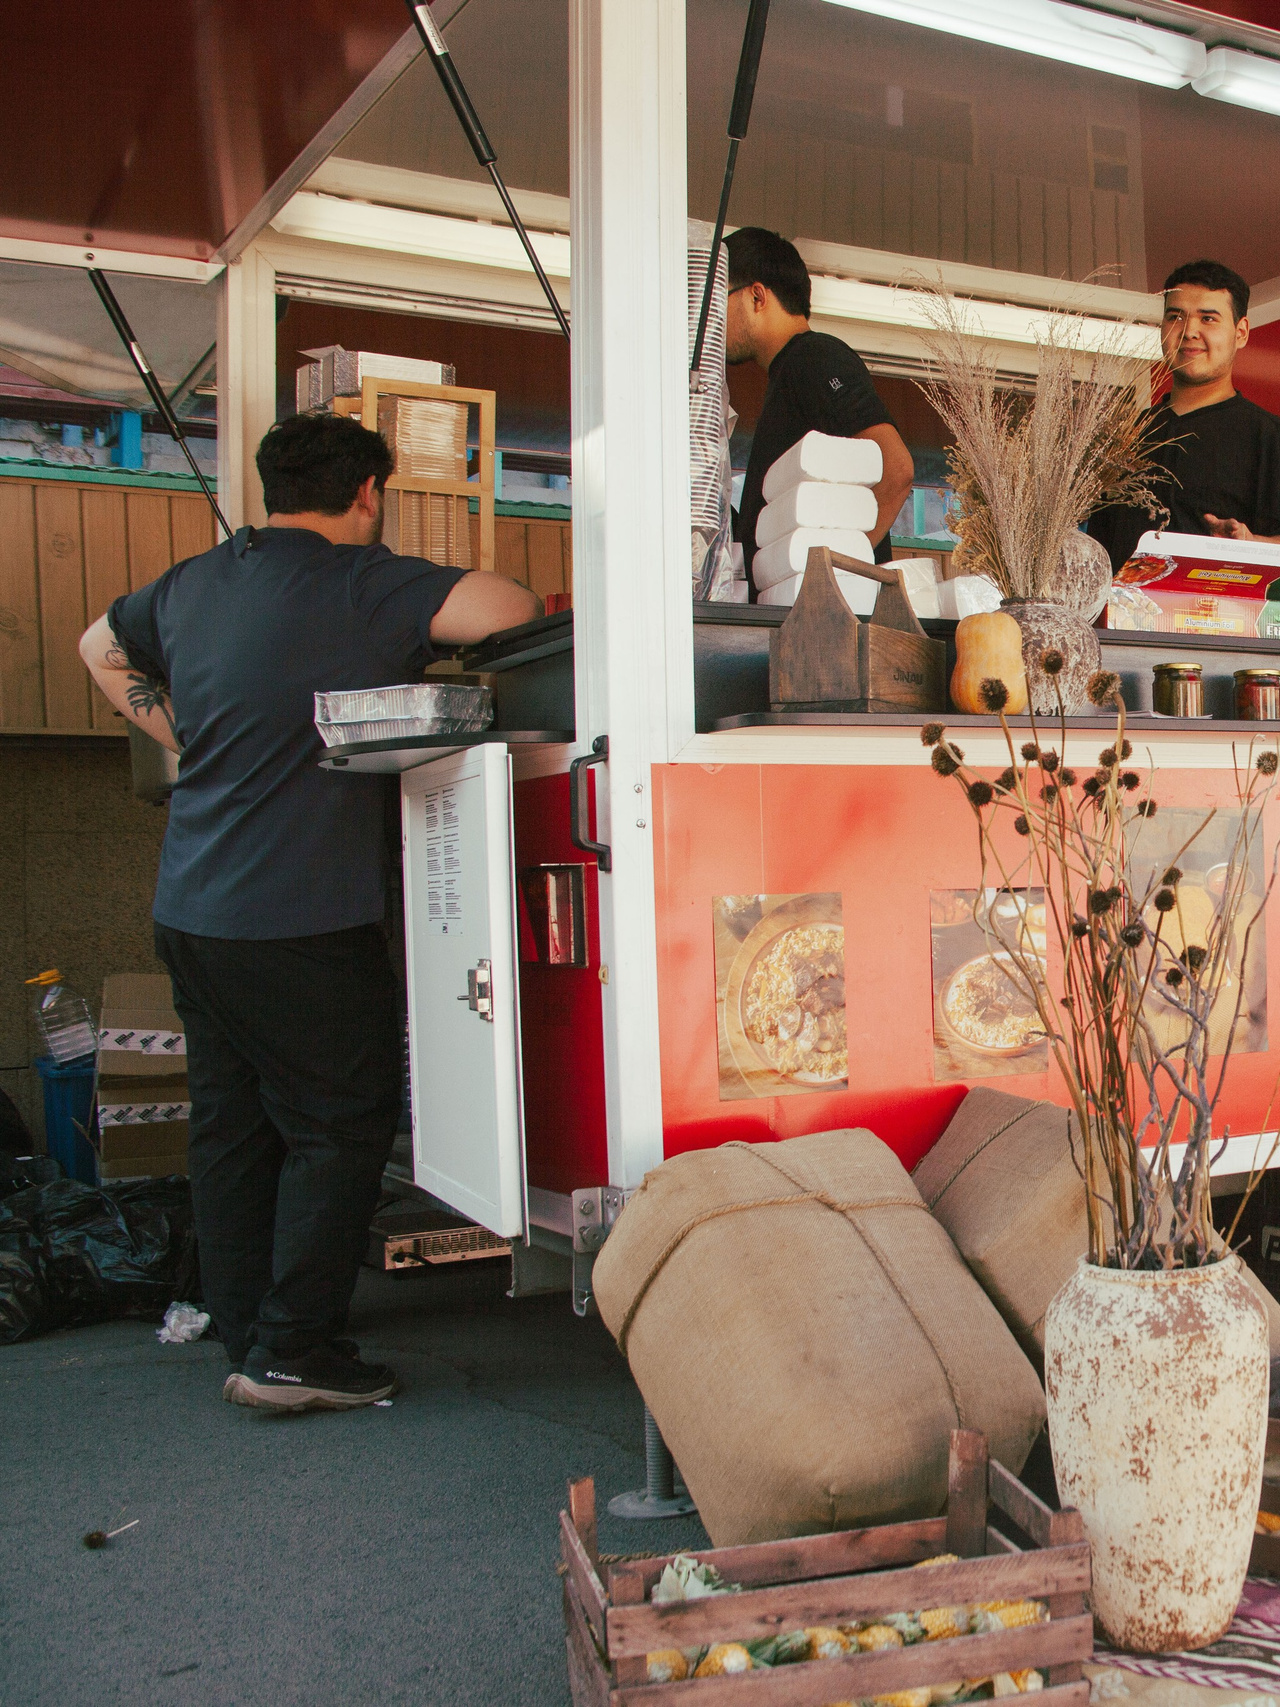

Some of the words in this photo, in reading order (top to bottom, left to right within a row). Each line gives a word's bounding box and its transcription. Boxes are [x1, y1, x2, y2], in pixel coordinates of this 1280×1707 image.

[1184, 617, 1221, 629] Aluminium
[1222, 620, 1235, 629] Foil
[273, 1371, 302, 1383] Columbia
